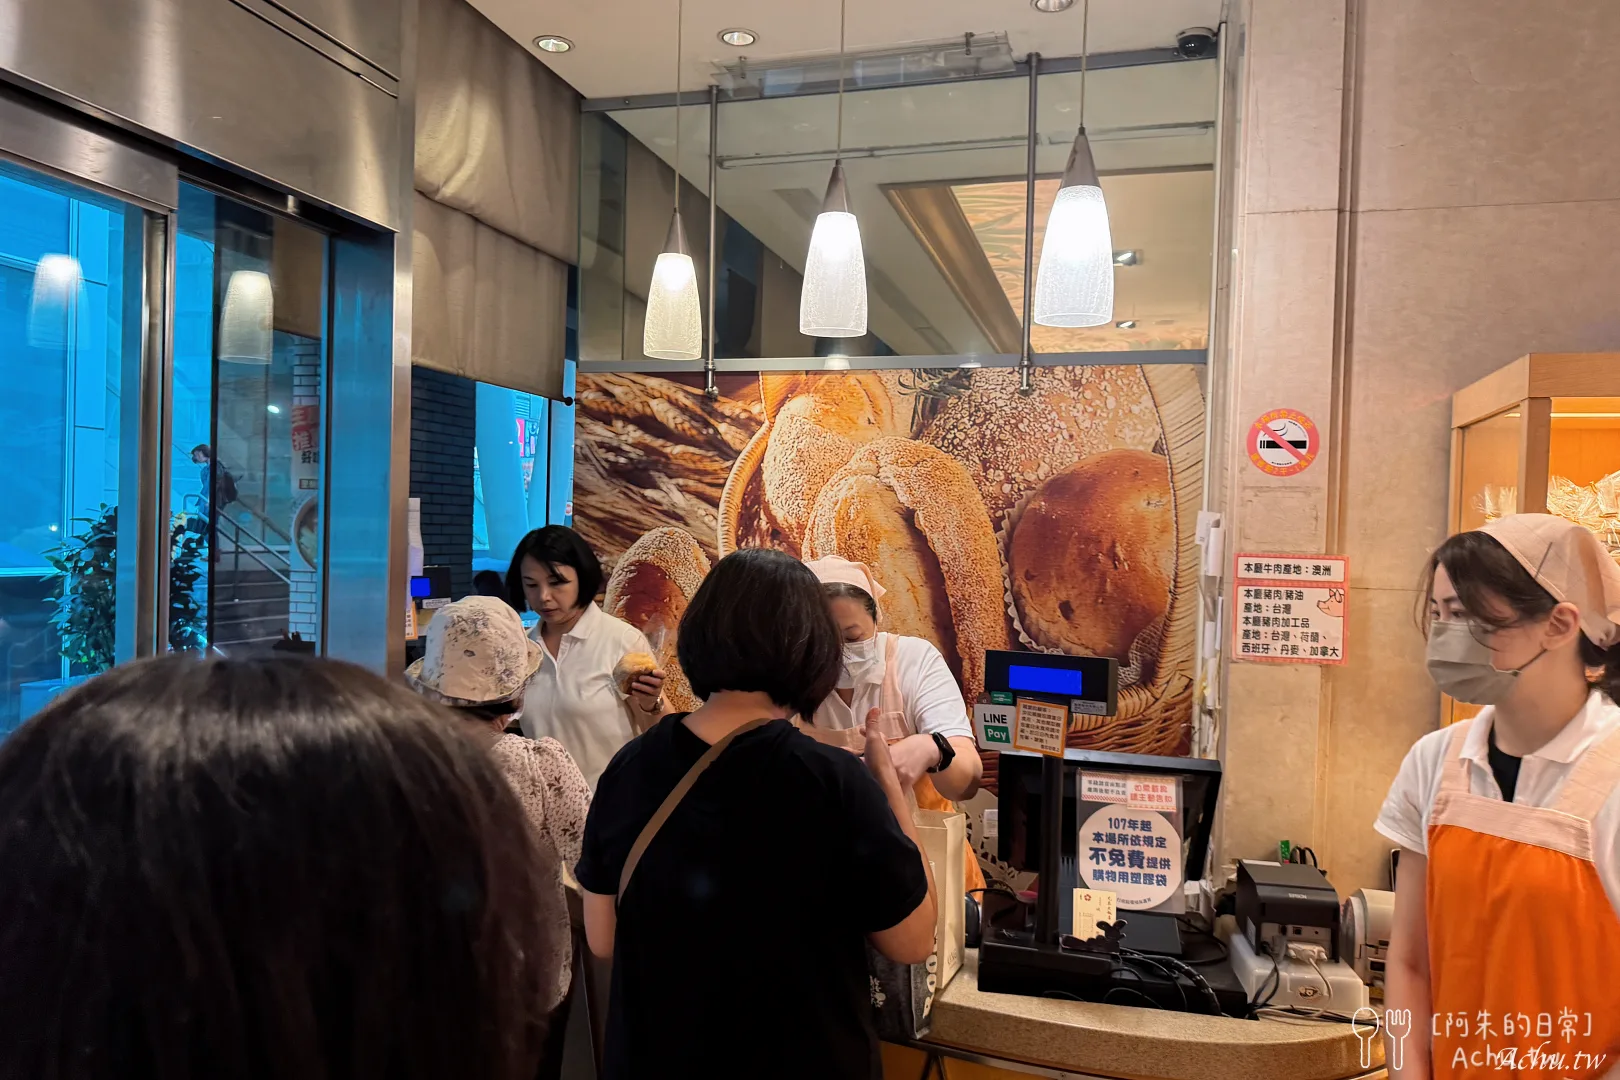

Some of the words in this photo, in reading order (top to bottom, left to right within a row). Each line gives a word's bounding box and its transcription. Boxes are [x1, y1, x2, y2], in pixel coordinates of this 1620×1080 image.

[983, 713, 1008, 724] LINE
[987, 728, 1007, 741] Pay
[1108, 817, 1152, 832] 107年起
[1092, 831, 1167, 849] 本場所依規定
[1092, 869, 1168, 887] 購物用塑膠袋
